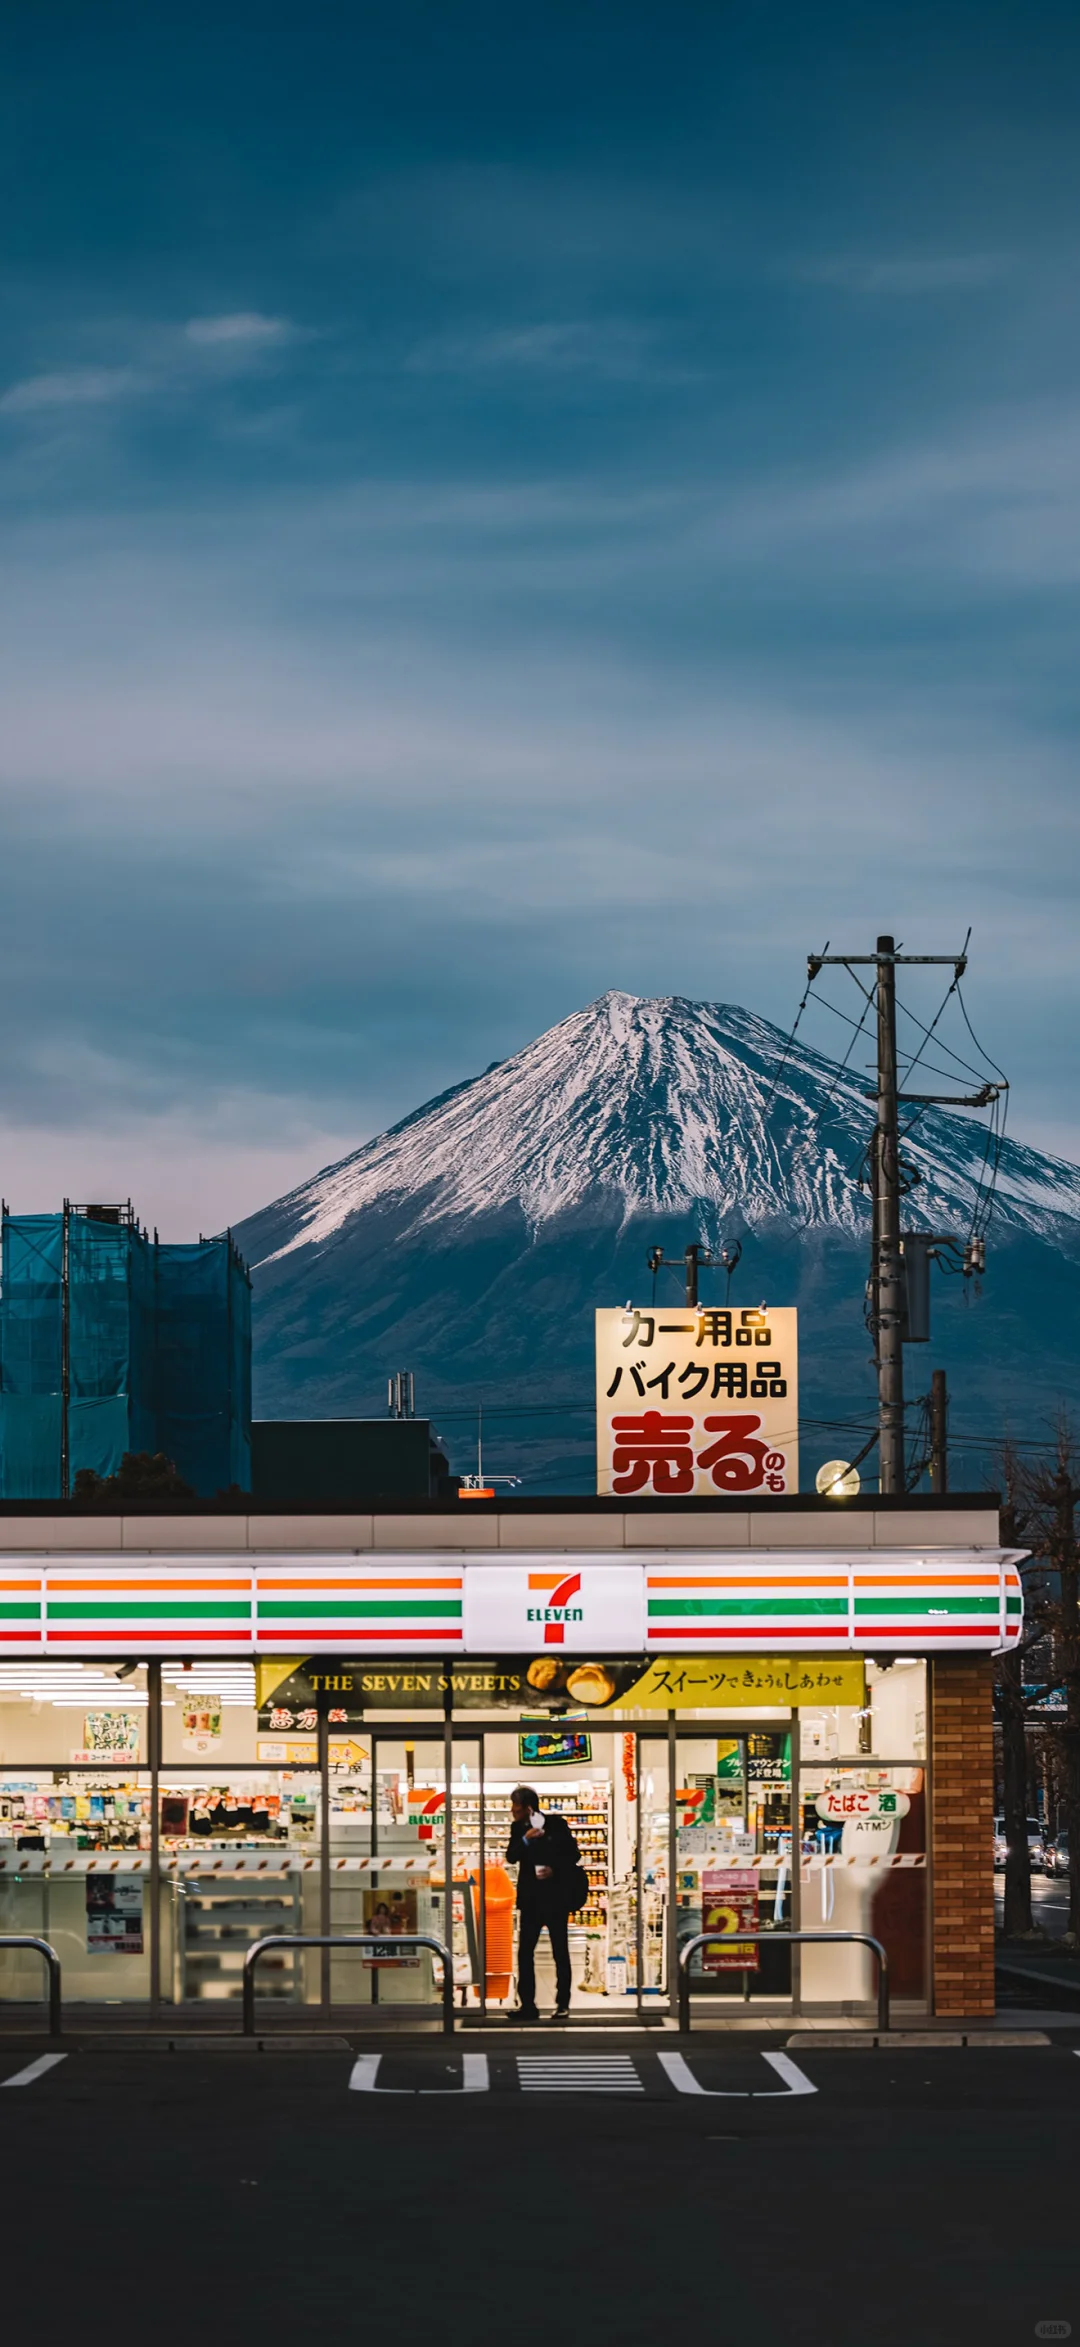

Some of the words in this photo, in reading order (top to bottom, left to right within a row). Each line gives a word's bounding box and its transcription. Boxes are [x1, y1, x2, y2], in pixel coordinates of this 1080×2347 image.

[621, 1310, 771, 1347] カー用品
[606, 1361, 787, 1399] バイク用品
[528, 1573, 581, 1643] 7
[309, 1675, 353, 1691] THE
[361, 1675, 432, 1691] SEVEN
[437, 1675, 521, 1691] SWEETS
[649, 1669, 844, 1695] スイーツできょうもしあわせ
[828, 1794, 870, 1812] たばこ
[878, 1793, 897, 1812] 酒
[855, 1821, 882, 1832] ATM
